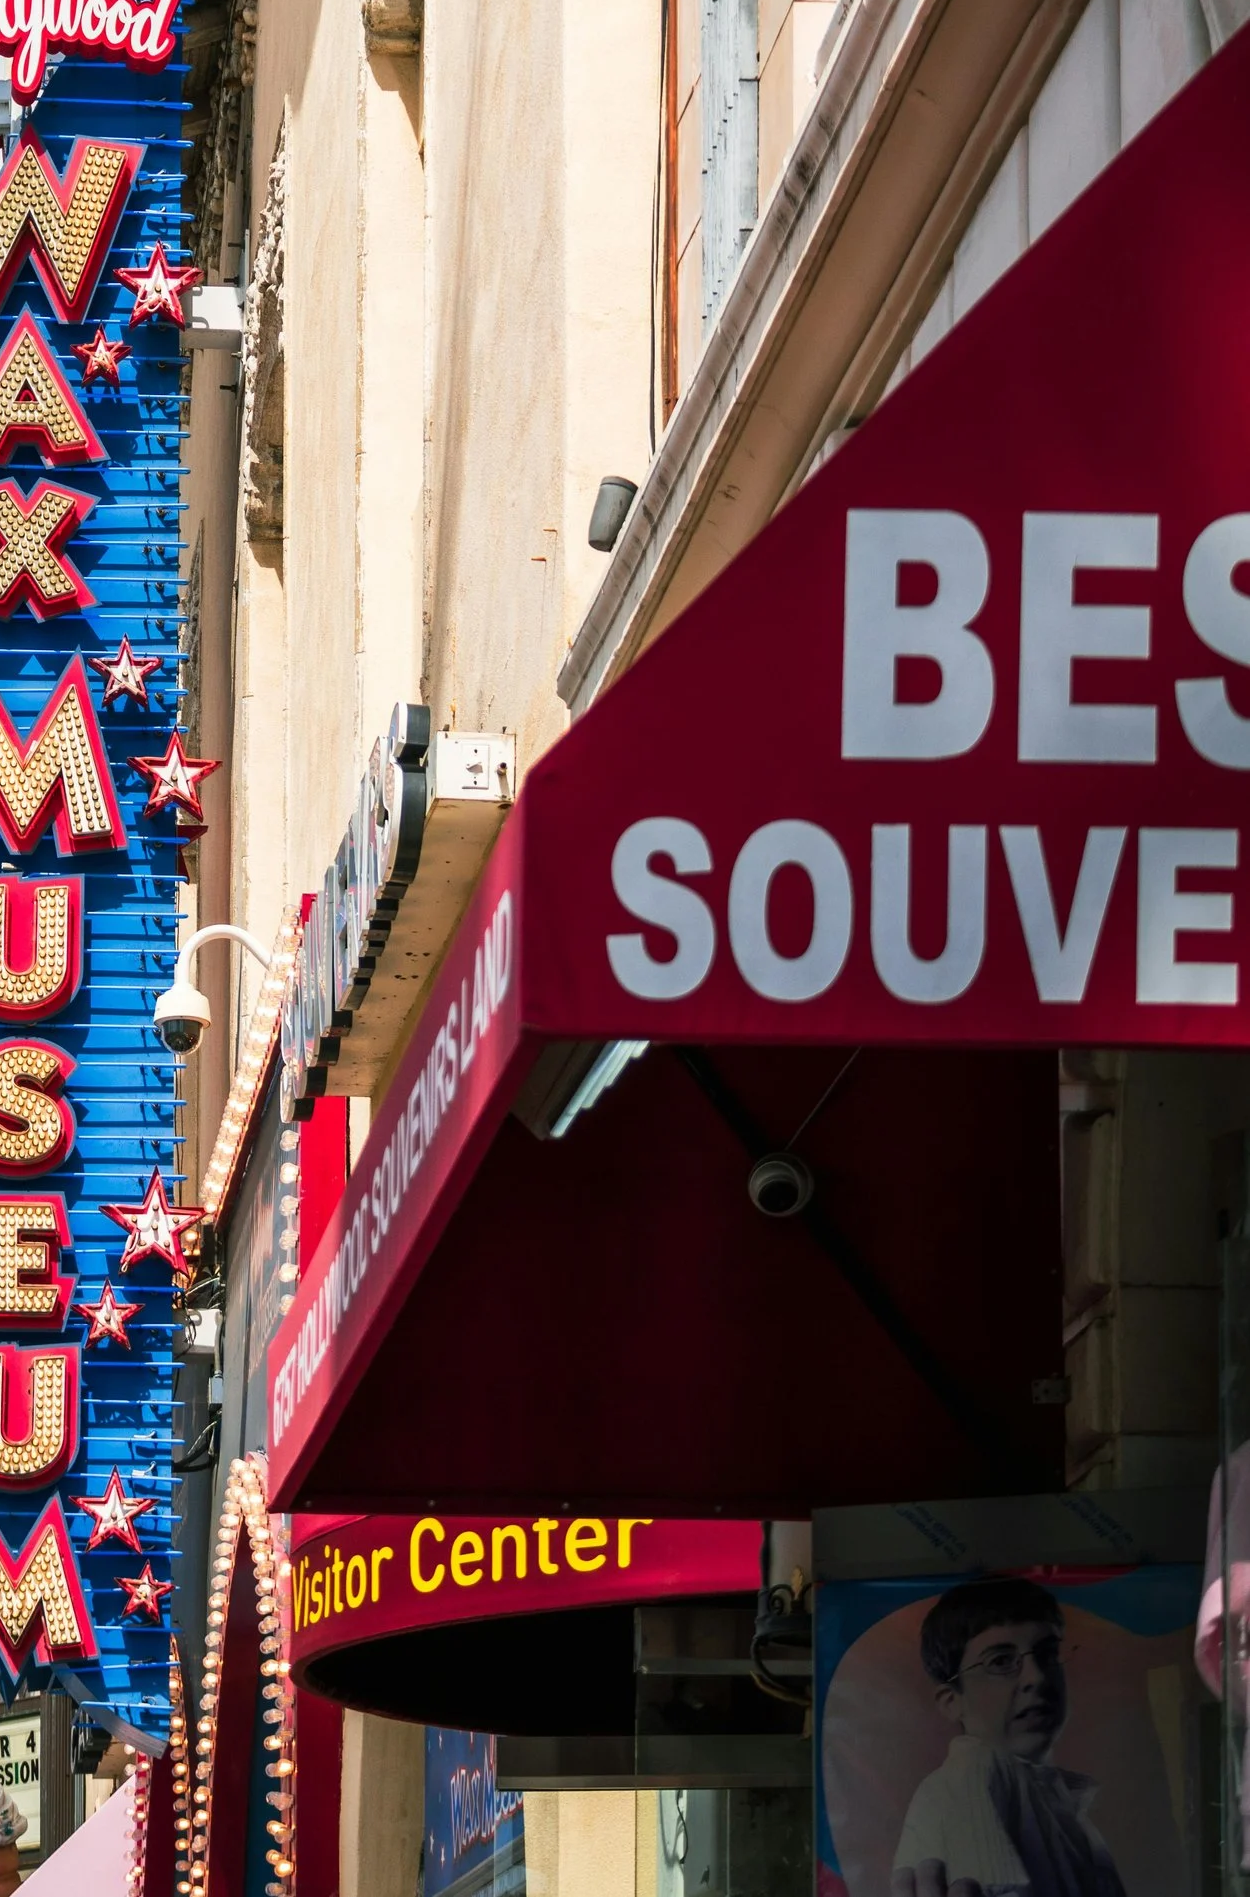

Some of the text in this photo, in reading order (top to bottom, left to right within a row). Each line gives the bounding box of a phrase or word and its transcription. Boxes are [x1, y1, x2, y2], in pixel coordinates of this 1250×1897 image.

[606, 815, 1239, 1005] SOUVE
[297, 1197, 369, 1396] HOLLYWOOD
[370, 1015, 459, 1254] SOUVENIRS
[459, 889, 514, 1075] LAND
[291, 1517, 653, 1633] Visitor Center
[26, 1730, 36, 1753] 4
[450, 1768, 481, 1861] WAX
